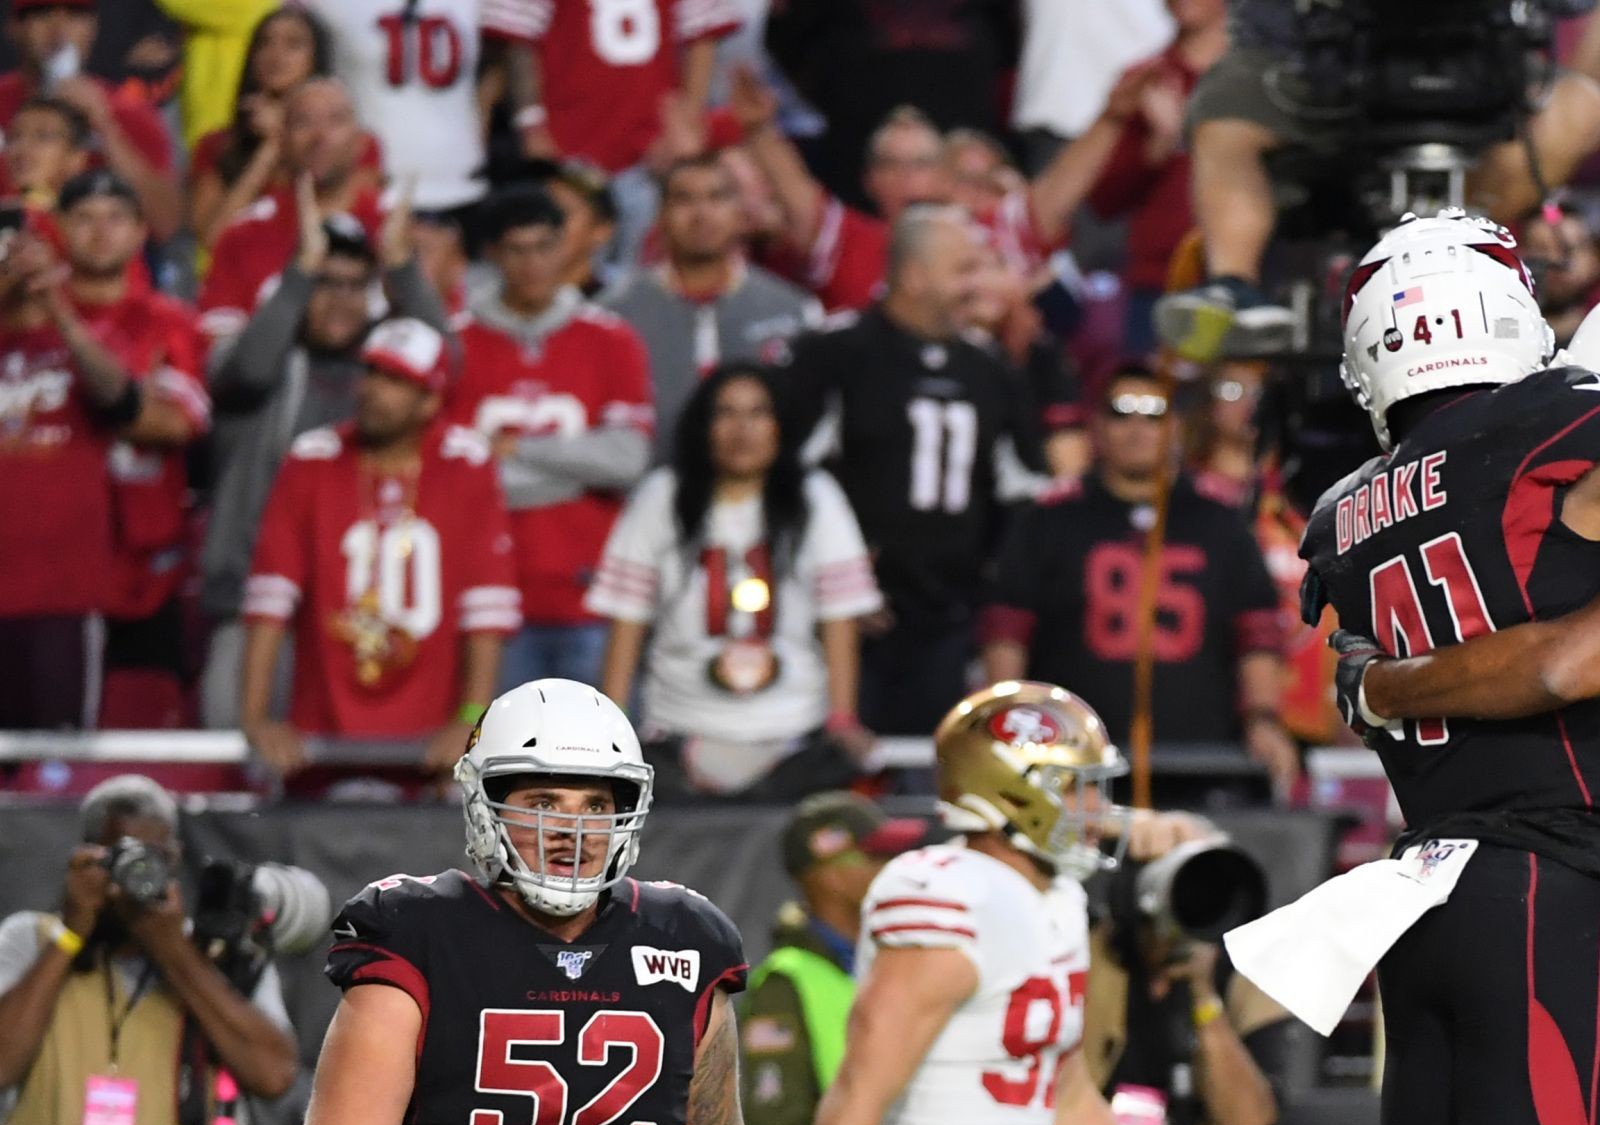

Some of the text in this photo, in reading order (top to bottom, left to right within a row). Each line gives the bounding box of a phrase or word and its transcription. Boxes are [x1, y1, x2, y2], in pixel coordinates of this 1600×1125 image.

[377, 14, 461, 89] 10
[1407, 356, 1488, 377] CARDINALS
[907, 398, 978, 513] 11
[1335, 450, 1447, 556] DRAKE
[339, 518, 442, 640] 10
[1084, 541, 1208, 661] 85
[1369, 531, 1498, 746] 41
[526, 989, 622, 1002] CARDINALS
[643, 954, 691, 980] WVB
